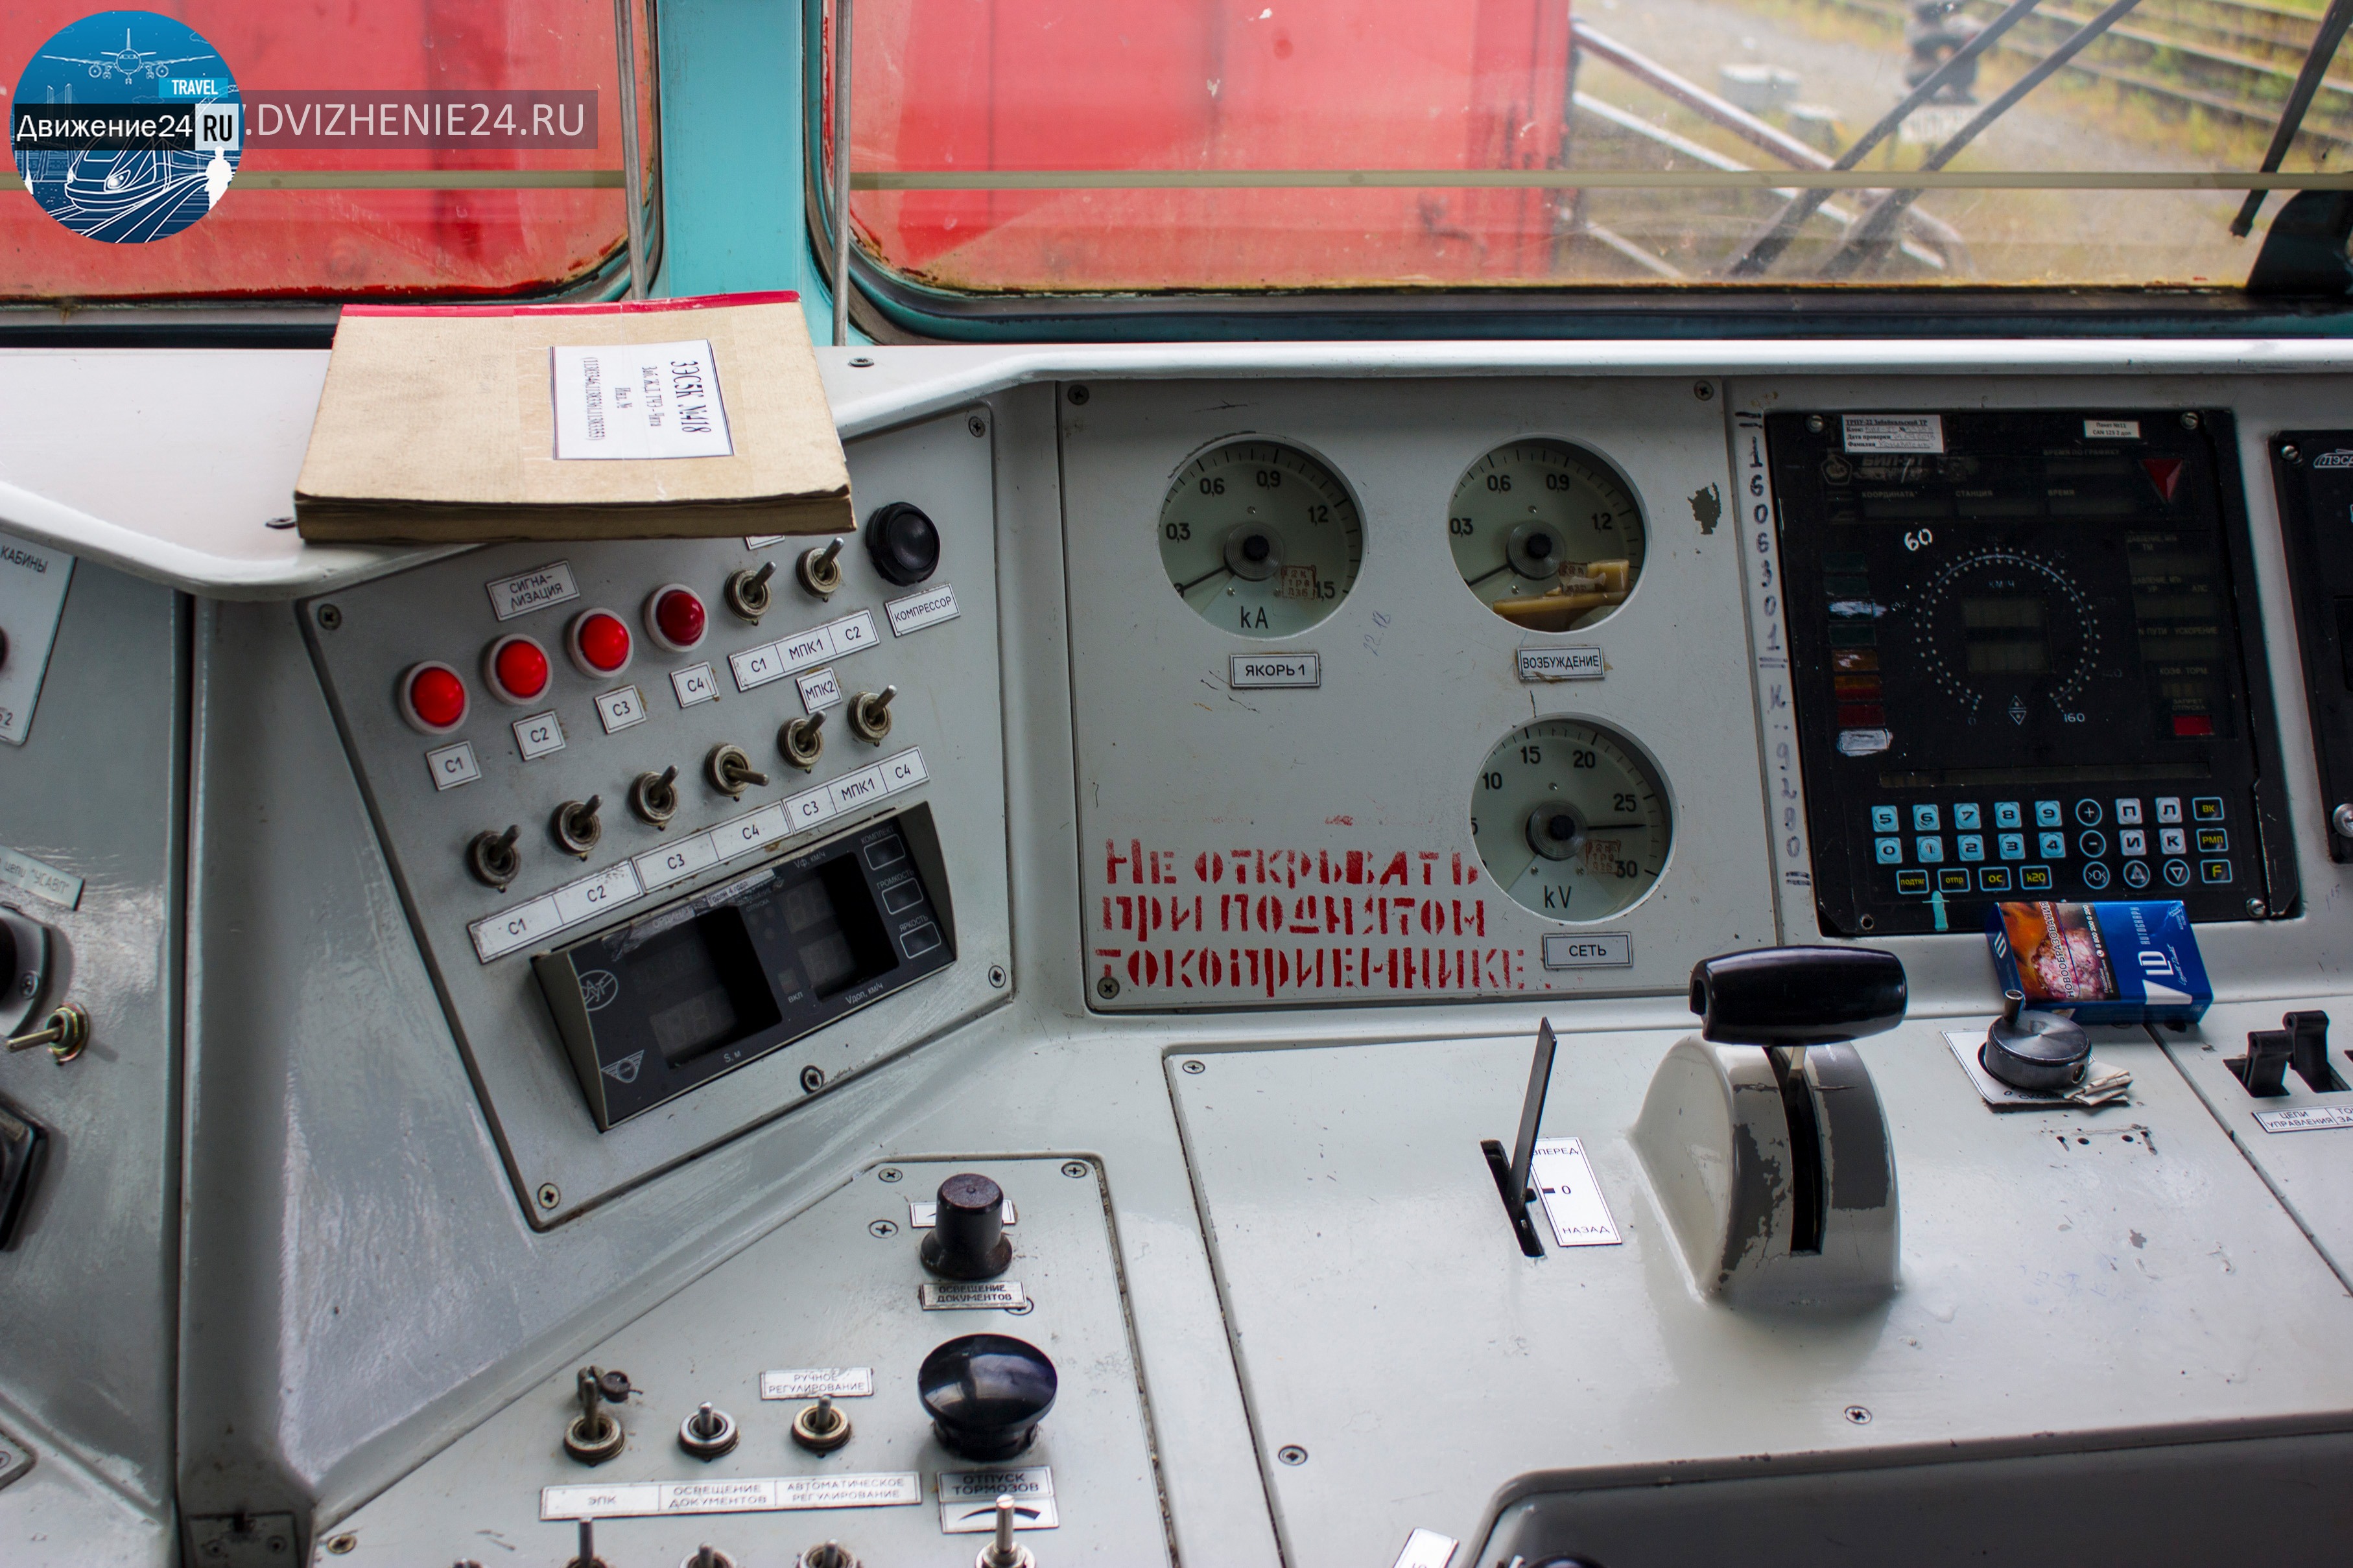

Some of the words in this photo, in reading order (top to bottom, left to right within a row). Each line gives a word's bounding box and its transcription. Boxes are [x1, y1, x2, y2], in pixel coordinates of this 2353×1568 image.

[1200, 477, 1225, 496] 0,6
[1257, 470, 1281, 490] 0,9
[1487, 474, 1511, 494] 0,6
[1546, 473, 1570, 493] 0,9
[1308, 505, 1329, 526] 1,2
[1592, 512, 1613, 533] 1,2
[1166, 522, 1190, 543] 0,3
[1450, 517, 1474, 537] 0,3
[1904, 528, 1933, 551] 60
[1, 544, 49, 574] КАБИНЫ
[509, 574, 553, 594] СИГНА-
[1316, 581, 1335, 602] 1,5
[510, 582, 563, 609] ЛИЗАЦИЯ
[894, 595, 952, 623] КОМПРЕССОР
[788, 638, 825, 660] МПК1
[845, 626, 862, 641] С2
[1245, 664, 1295, 677] ЯКОРЬ
[1298, 664, 1305, 676] 1
[1522, 655, 1600, 671] ВОЗБУЖДЕНИЕ
[687, 677, 705, 693] С4
[805, 681, 836, 701] МПК2
[612, 701, 631, 717] С3
[2064, 713, 2086, 723] 160
[530, 727, 550, 743] С2
[1520, 746, 1542, 765] 15
[1572, 749, 1596, 769] 20
[841, 777, 876, 802] МПК1
[894, 763, 912, 779] С4
[1482, 771, 1502, 791] 10
[1613, 793, 1637, 813] 25
[1880, 813, 1891, 823] 5
[1921, 813, 1932, 822] 6
[1961, 810, 1974, 821] 7
[2002, 810, 2015, 819] 8
[2042, 808, 2055, 818] 9
[2122, 806, 2137, 817] П
[860, 825, 894, 845] КОМПЛЕКТ
[2126, 837, 2140, 847] И
[2167, 836, 2180, 846] К
[2202, 835, 2223, 845] РМП
[667, 854, 685, 871] С3
[742, 824, 761, 840] С4
[1883, 846, 1895, 855] 0
[1928, 843, 1935, 854] 1
[1965, 843, 1978, 852] 2
[2005, 841, 2018, 851] 3
[2046, 840, 2059, 850] 4
[1614, 860, 1638, 879] 30
[2212, 865, 2222, 878] F
[877, 869, 915, 891] ГРОМКОСТЬ
[587, 885, 606, 903] С2
[899, 914, 928, 933] ЯРКОСТЬ
[1102, 894, 1203, 942] ПРИ
[1220, 893, 1485, 937] ПОДНЯТОМ
[1568, 944, 1607, 957] СЕТЬ
[2039, 901, 2075, 999] НОВООБРАЗОВАНИЯ
[2138, 950, 2174, 976] LD
[787, 990, 804, 1003] ВКЛ
[2267, 1117, 2334, 1128] УПРАВЛЕНИЯ
[2279, 1111, 2309, 1119] ЦЕПИ
[1562, 1226, 1610, 1234] НАЗАД
[938, 1284, 1007, 1294] ОСВЕЩЕНИЕ
[936, 1293, 1012, 1304] ДОКУМЕНТОВ
[793, 1373, 839, 1383] РУЧНОЕ
[768, 1381, 865, 1394] РЕГУЛИРОВАНИЕ
[786, 1478, 905, 1492] АВТОМАТИЧЕСКОЕ
[963, 1473, 1025, 1484] ОТПУСК
[673, 1483, 763, 1496] ОСВЕЩЕНИЕ
[792, 1490, 900, 1503] РЕГУЛИРОВАНИЕ
[952, 1482, 1039, 1495] ТОРМОЗОВ
[587, 1495, 617, 1506] ЭПК
[668, 1495, 768, 1510] ДОКУМЕНТОВ
